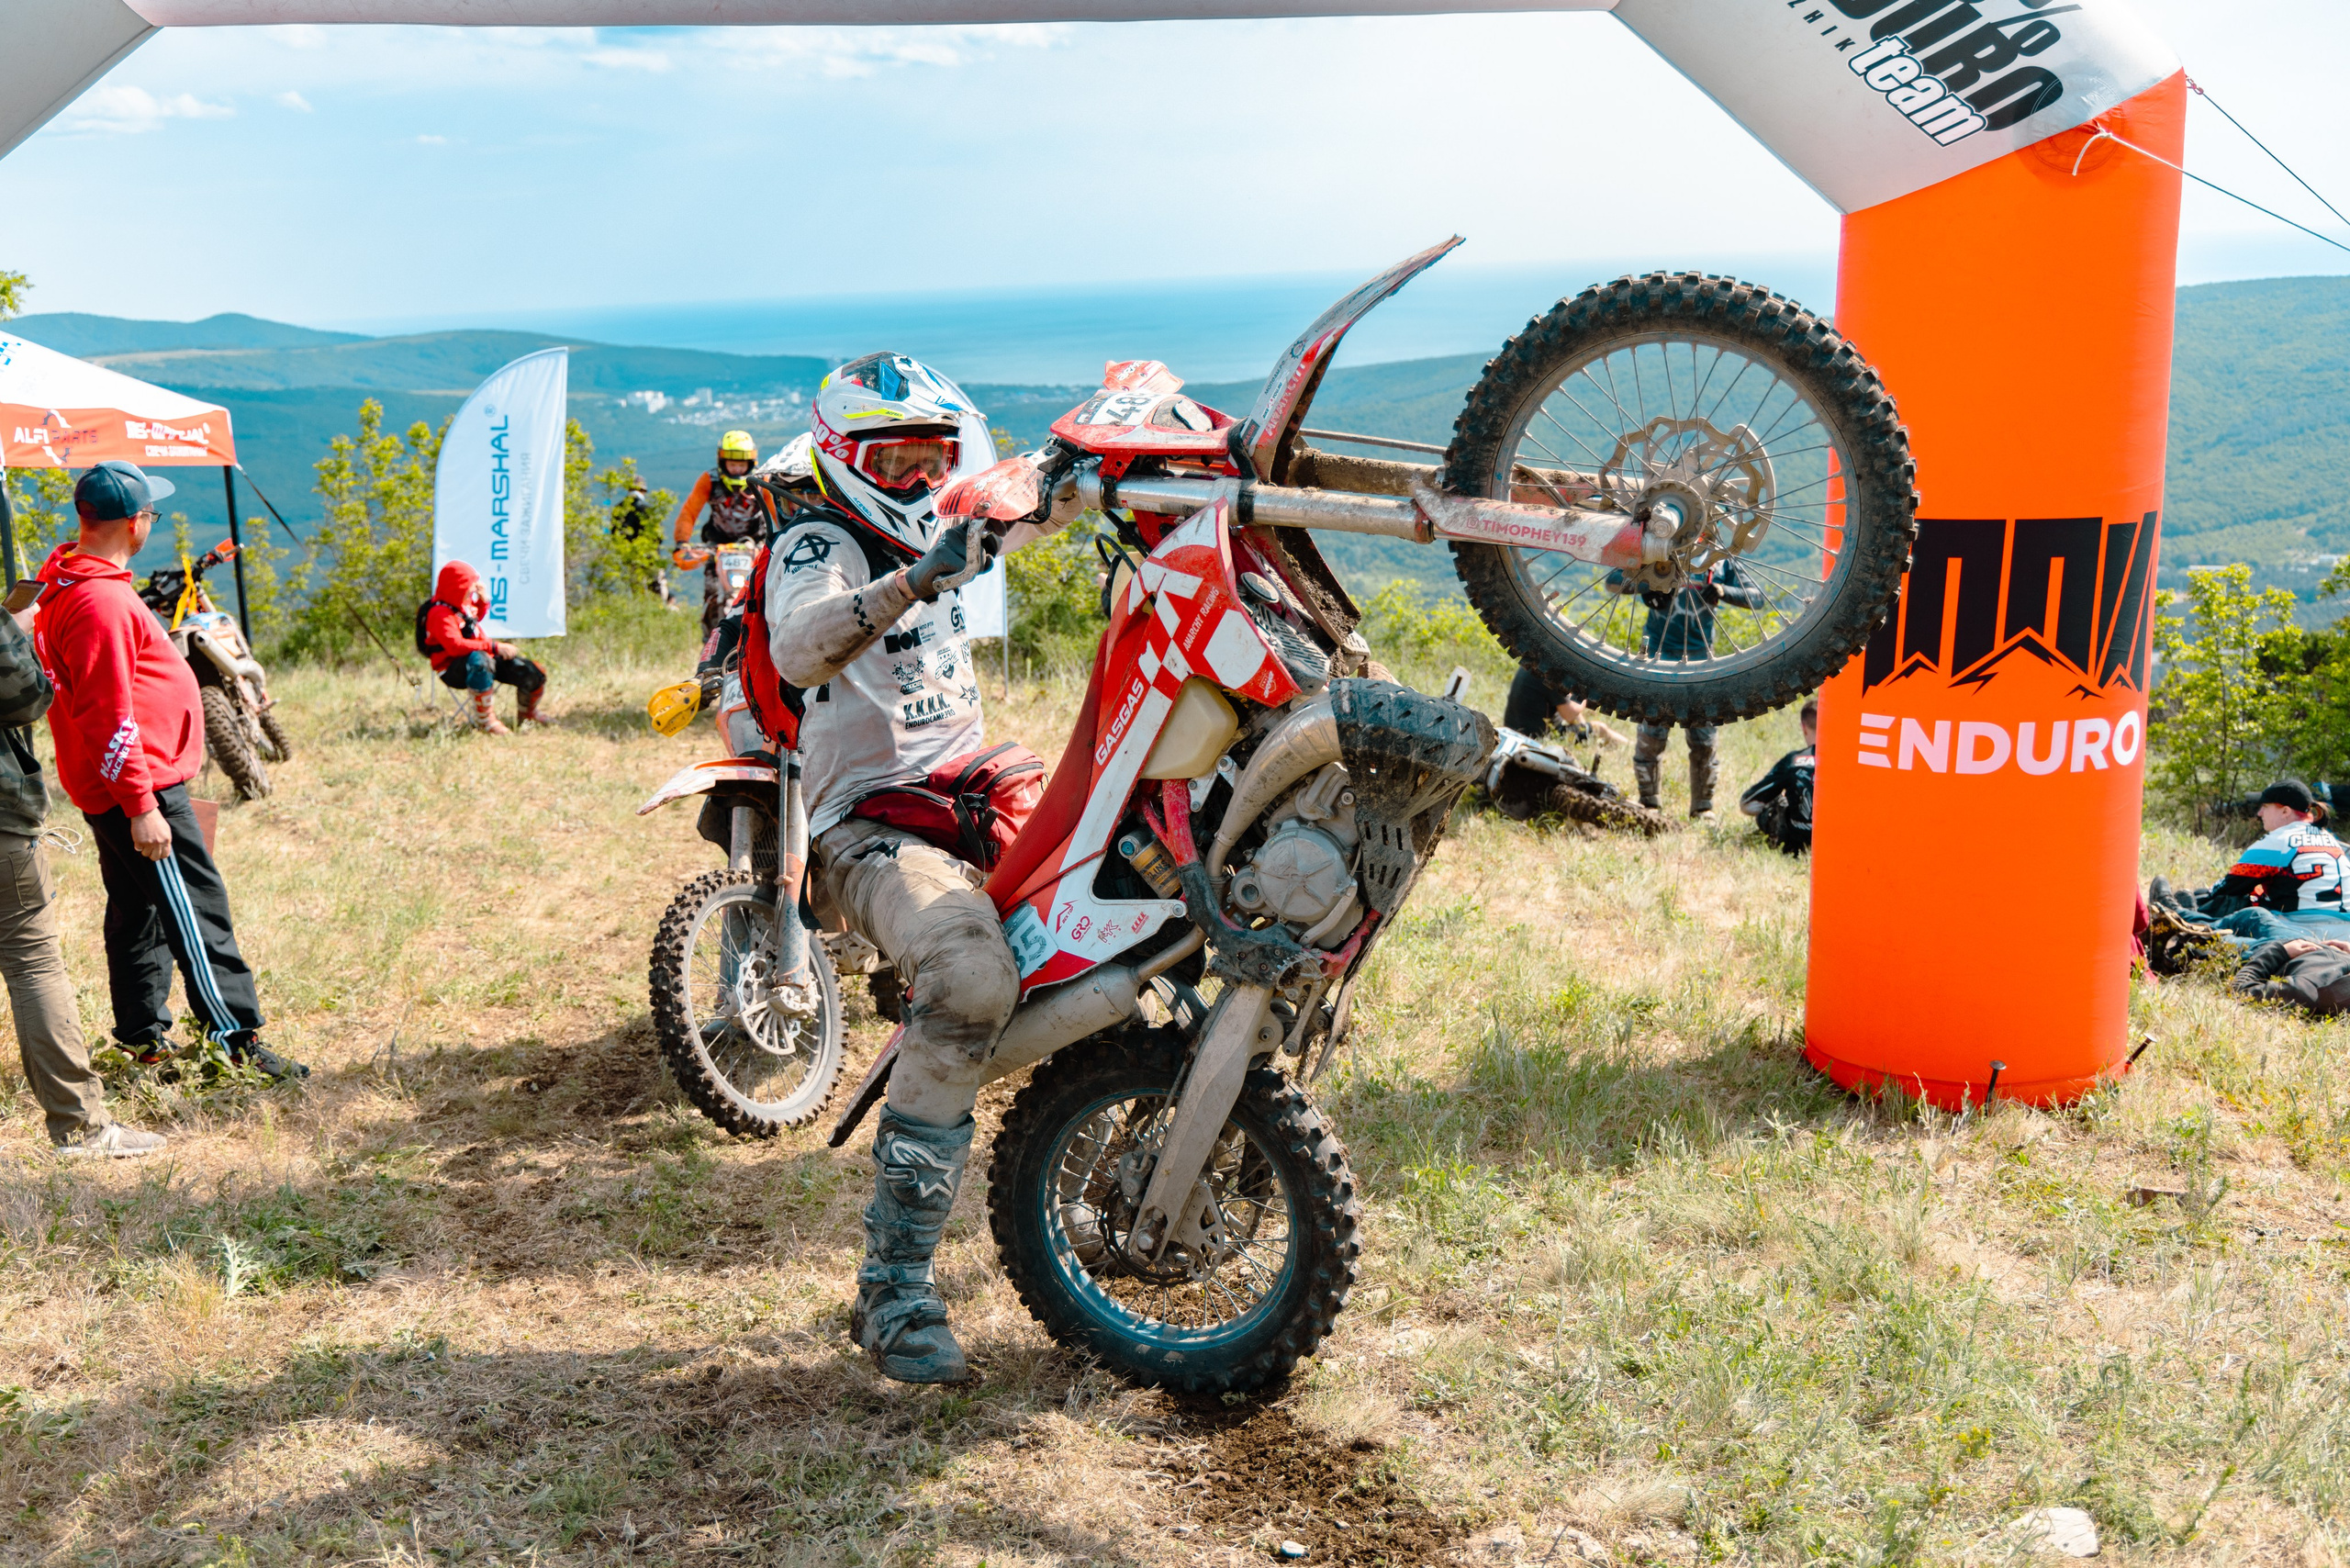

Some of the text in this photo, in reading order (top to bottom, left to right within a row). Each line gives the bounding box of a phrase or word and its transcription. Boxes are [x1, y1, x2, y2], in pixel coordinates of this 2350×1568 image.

[1848, 34, 1988, 148] team
[520, 452, 532, 585] СВЕЧИ ЗАЖИГАНИЯ
[1483, 519, 1587, 548] TIMOPHEY139
[1182, 586, 1219, 652] ANARCHY RACING
[905, 709, 956, 730] ENDUROCAMP.PRO
[1095, 678, 1145, 766] GASGAS
[1857, 710, 2141, 776] ENDURO
[110, 745, 130, 783] RACING
